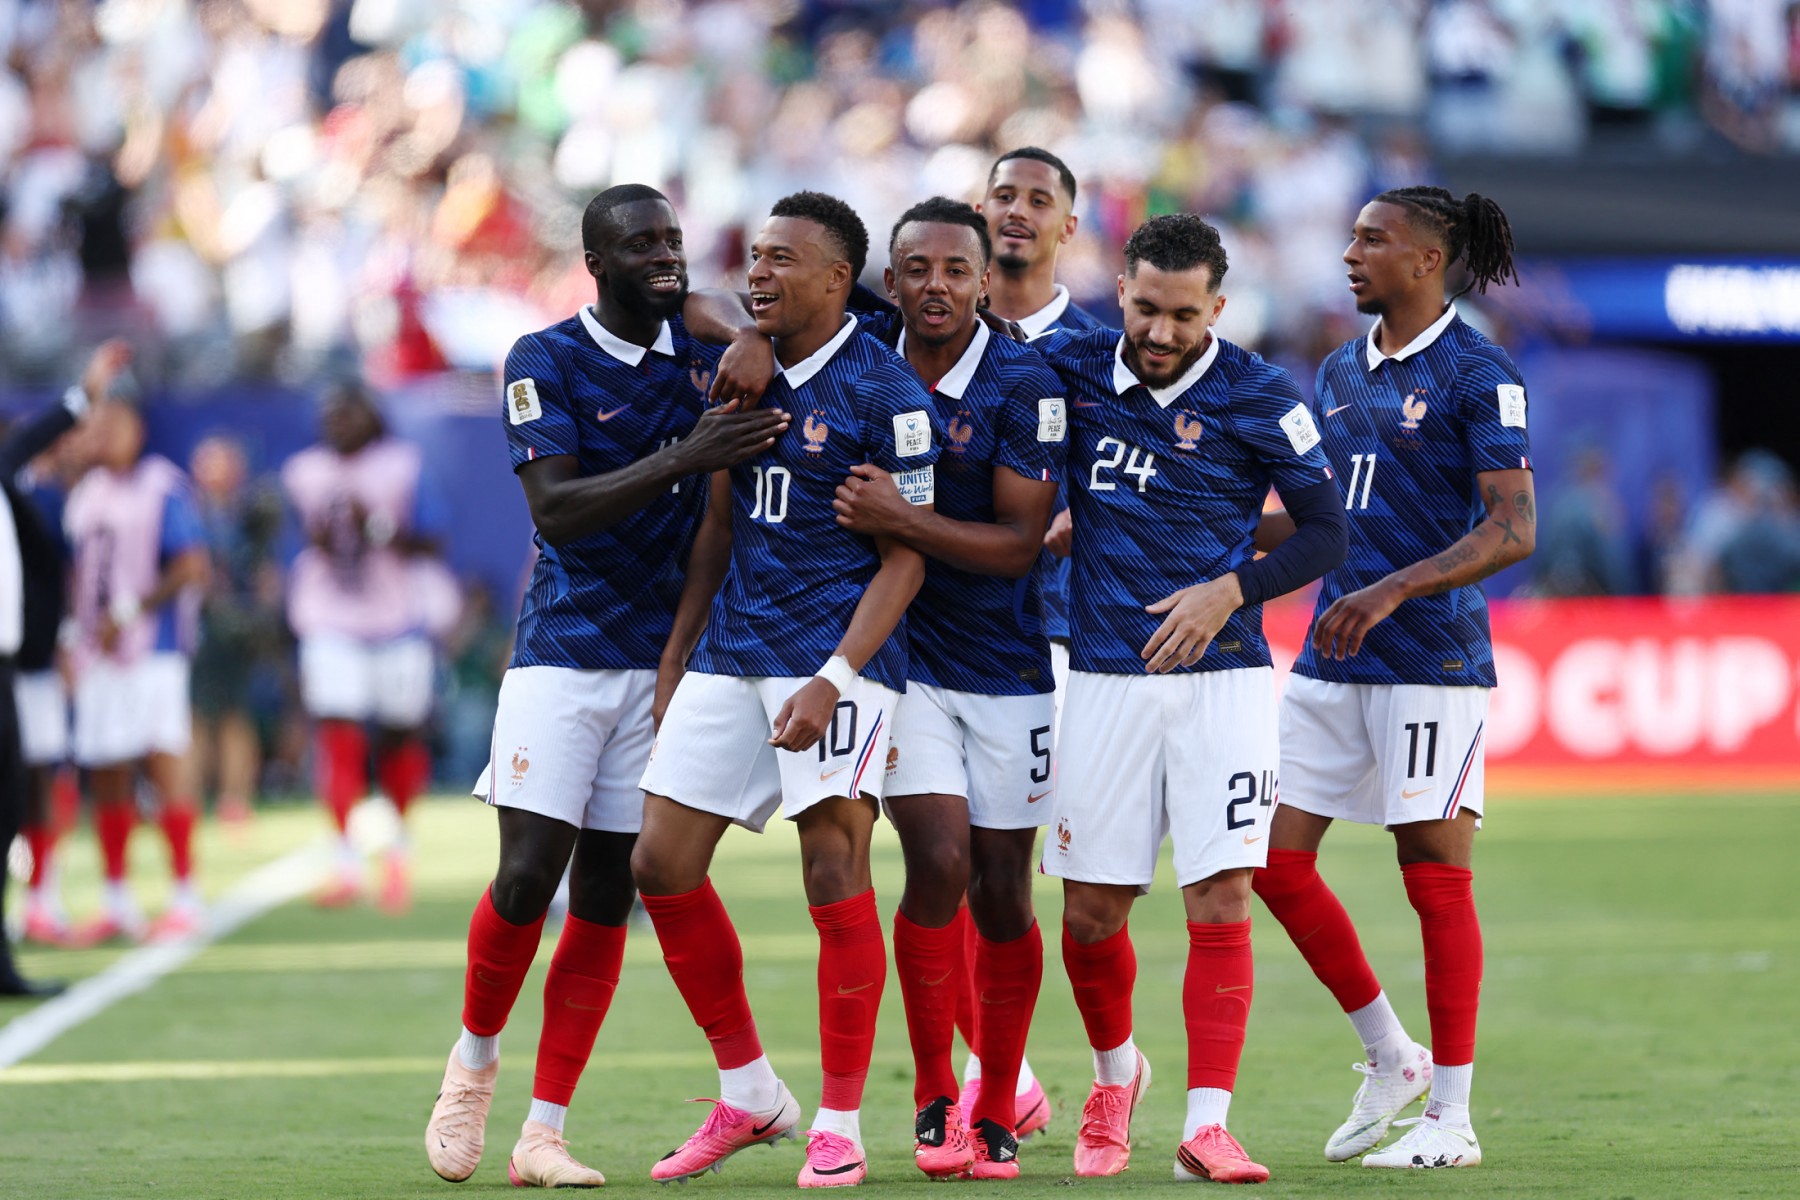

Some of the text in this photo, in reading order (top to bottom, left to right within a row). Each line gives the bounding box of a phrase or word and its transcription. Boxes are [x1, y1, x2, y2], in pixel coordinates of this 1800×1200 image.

[906, 438, 922, 447] PEACE
[1089, 436, 1157, 493] 24
[749, 466, 791, 523] 10
[899, 471, 933, 486] UNITES
[1345, 453, 1376, 510] 11
[1547, 637, 1790, 757] CUP
[1030, 725, 1050, 783] 5
[1404, 721, 1438, 778] 11
[1226, 770, 1273, 831] 24
